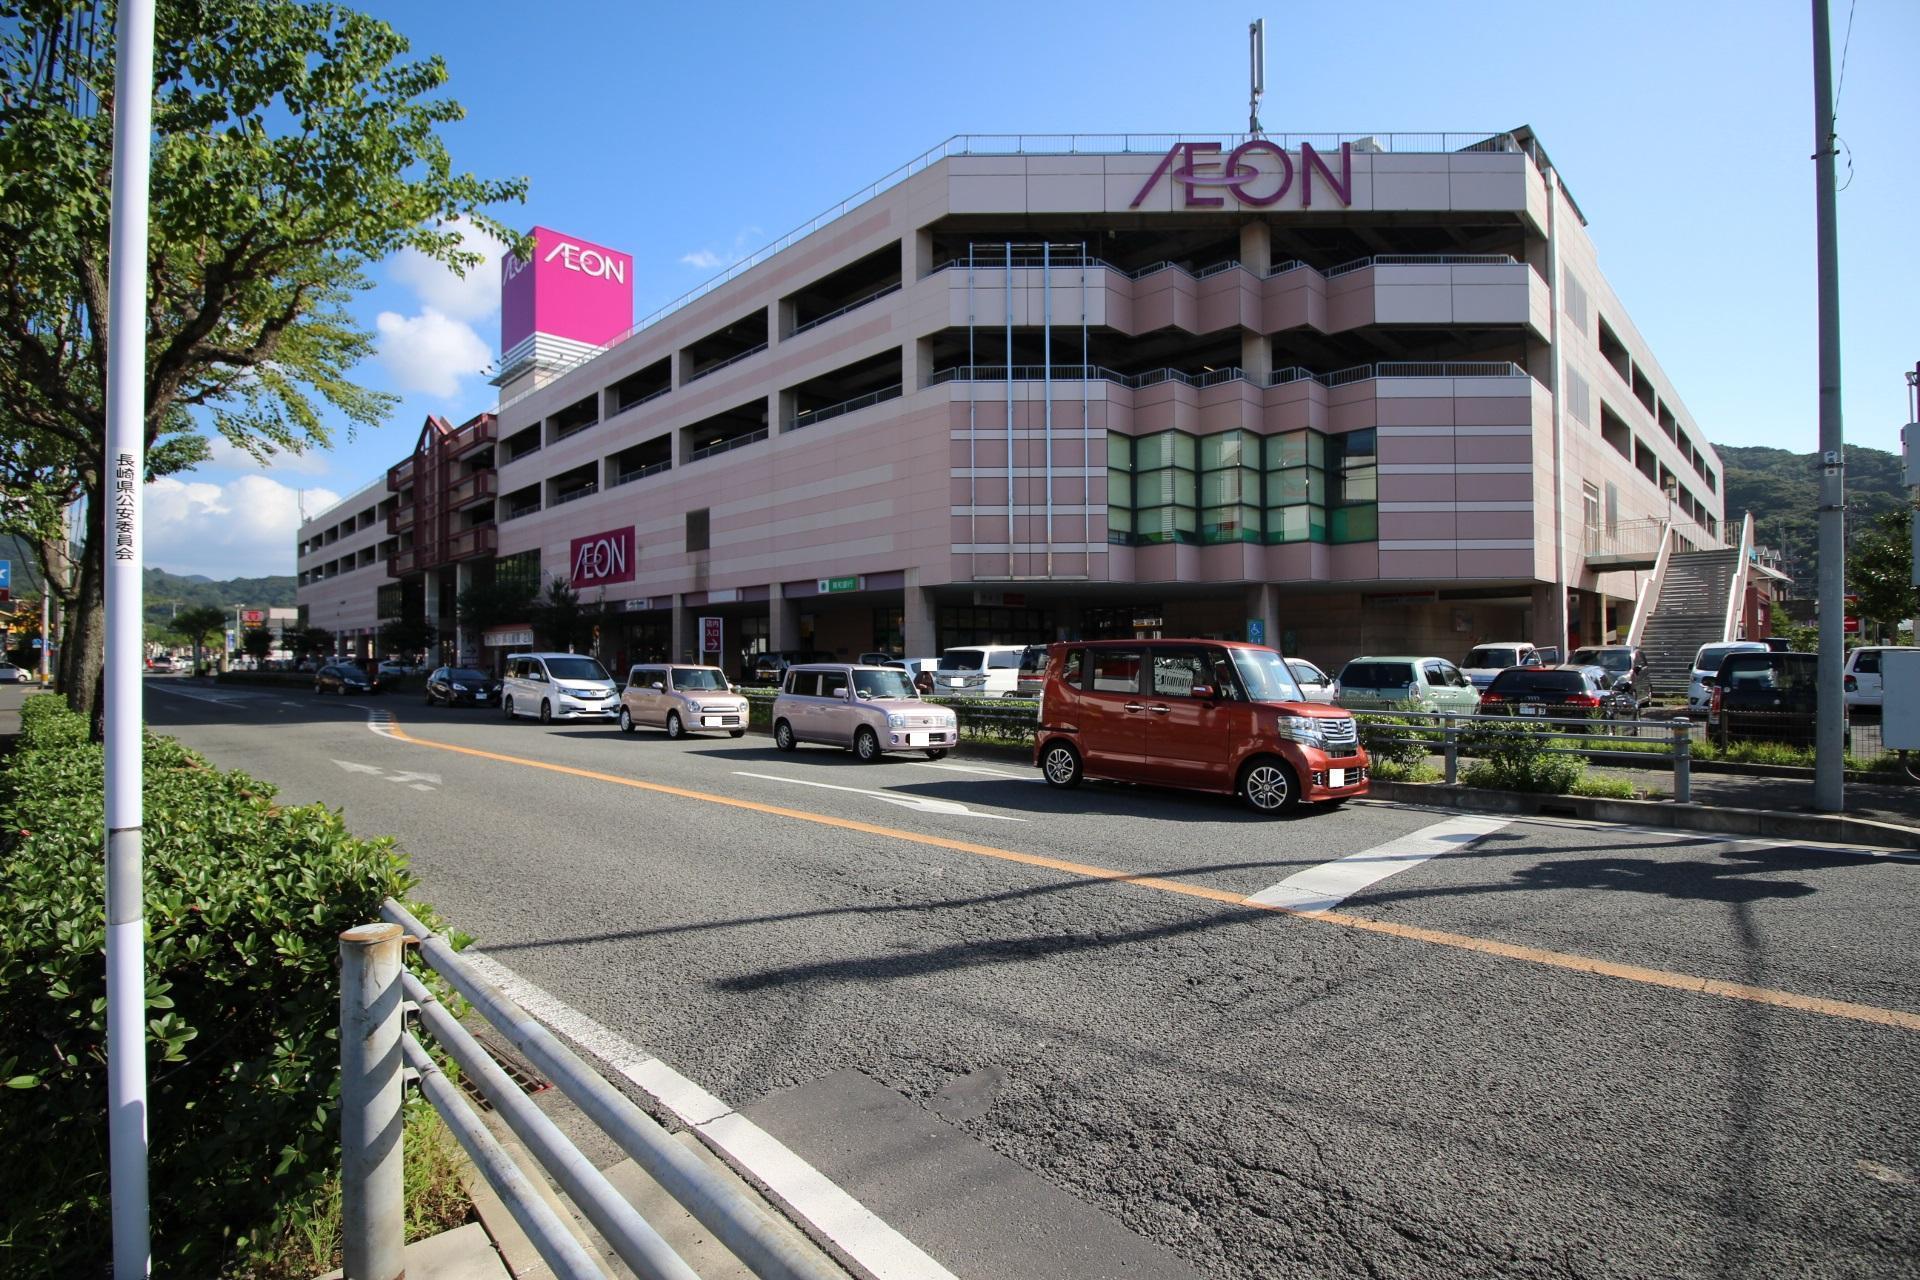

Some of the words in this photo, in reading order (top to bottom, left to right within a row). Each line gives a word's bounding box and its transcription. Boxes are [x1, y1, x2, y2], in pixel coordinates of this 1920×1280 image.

[115, 453, 135, 560] 長崎県公安委員会
[706, 629, 719, 637] 入口
